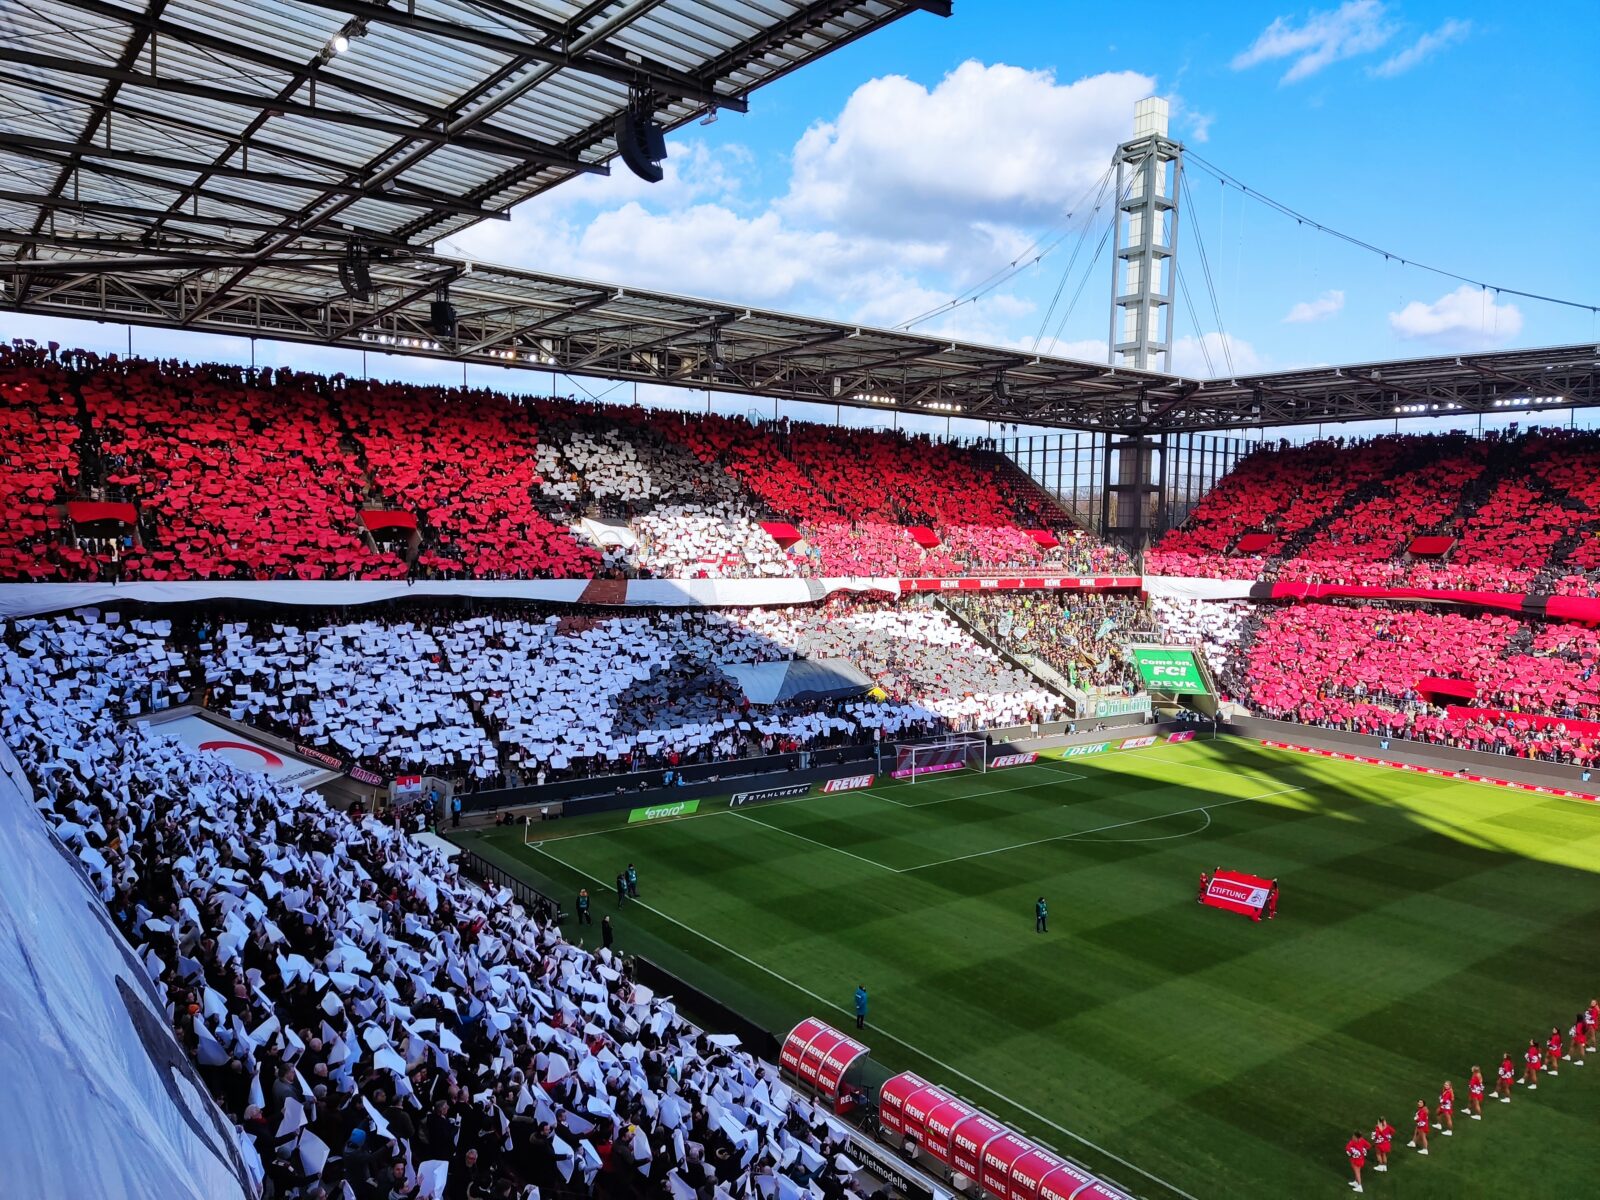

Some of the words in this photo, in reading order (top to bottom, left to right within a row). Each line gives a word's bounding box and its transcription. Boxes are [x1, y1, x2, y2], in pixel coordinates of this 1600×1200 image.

[941, 580, 960, 588] REWE
[980, 579, 999, 588] REWE
[1044, 579, 1062, 587] REWE
[1153, 665, 1187, 676] FC!
[1150, 680, 1198, 688] DEVK
[1070, 743, 1105, 757] DEVK
[999, 753, 1035, 767] REWE
[830, 774, 871, 792] REWE
[1211, 886, 1247, 900] STIFTUNG
[789, 1034, 807, 1049] REWE
[782, 1051, 798, 1067] REWE
[807, 1045, 826, 1060] REWE
[800, 1062, 817, 1078] REWE
[826, 1055, 845, 1071] REWE
[818, 1074, 836, 1090] REWE
[882, 1090, 902, 1108] REWE
[882, 1109, 901, 1127] REWE
[905, 1103, 926, 1122] REWE
[904, 1123, 925, 1142] REWE
[928, 1117, 950, 1137] REWE
[927, 1138, 949, 1158] REWE
[955, 1133, 978, 1154] REWE
[1005, 1134, 1032, 1151] REWE
[954, 1155, 977, 1176] REWE
[984, 1152, 1009, 1174] REWE
[1032, 1150, 1060, 1167] REWE
[858, 1151, 908, 1193] Mietmodelle
[1011, 1168, 1038, 1191] REWE
[1061, 1166, 1090, 1184] REWE
[984, 1173, 1008, 1195] REWE
